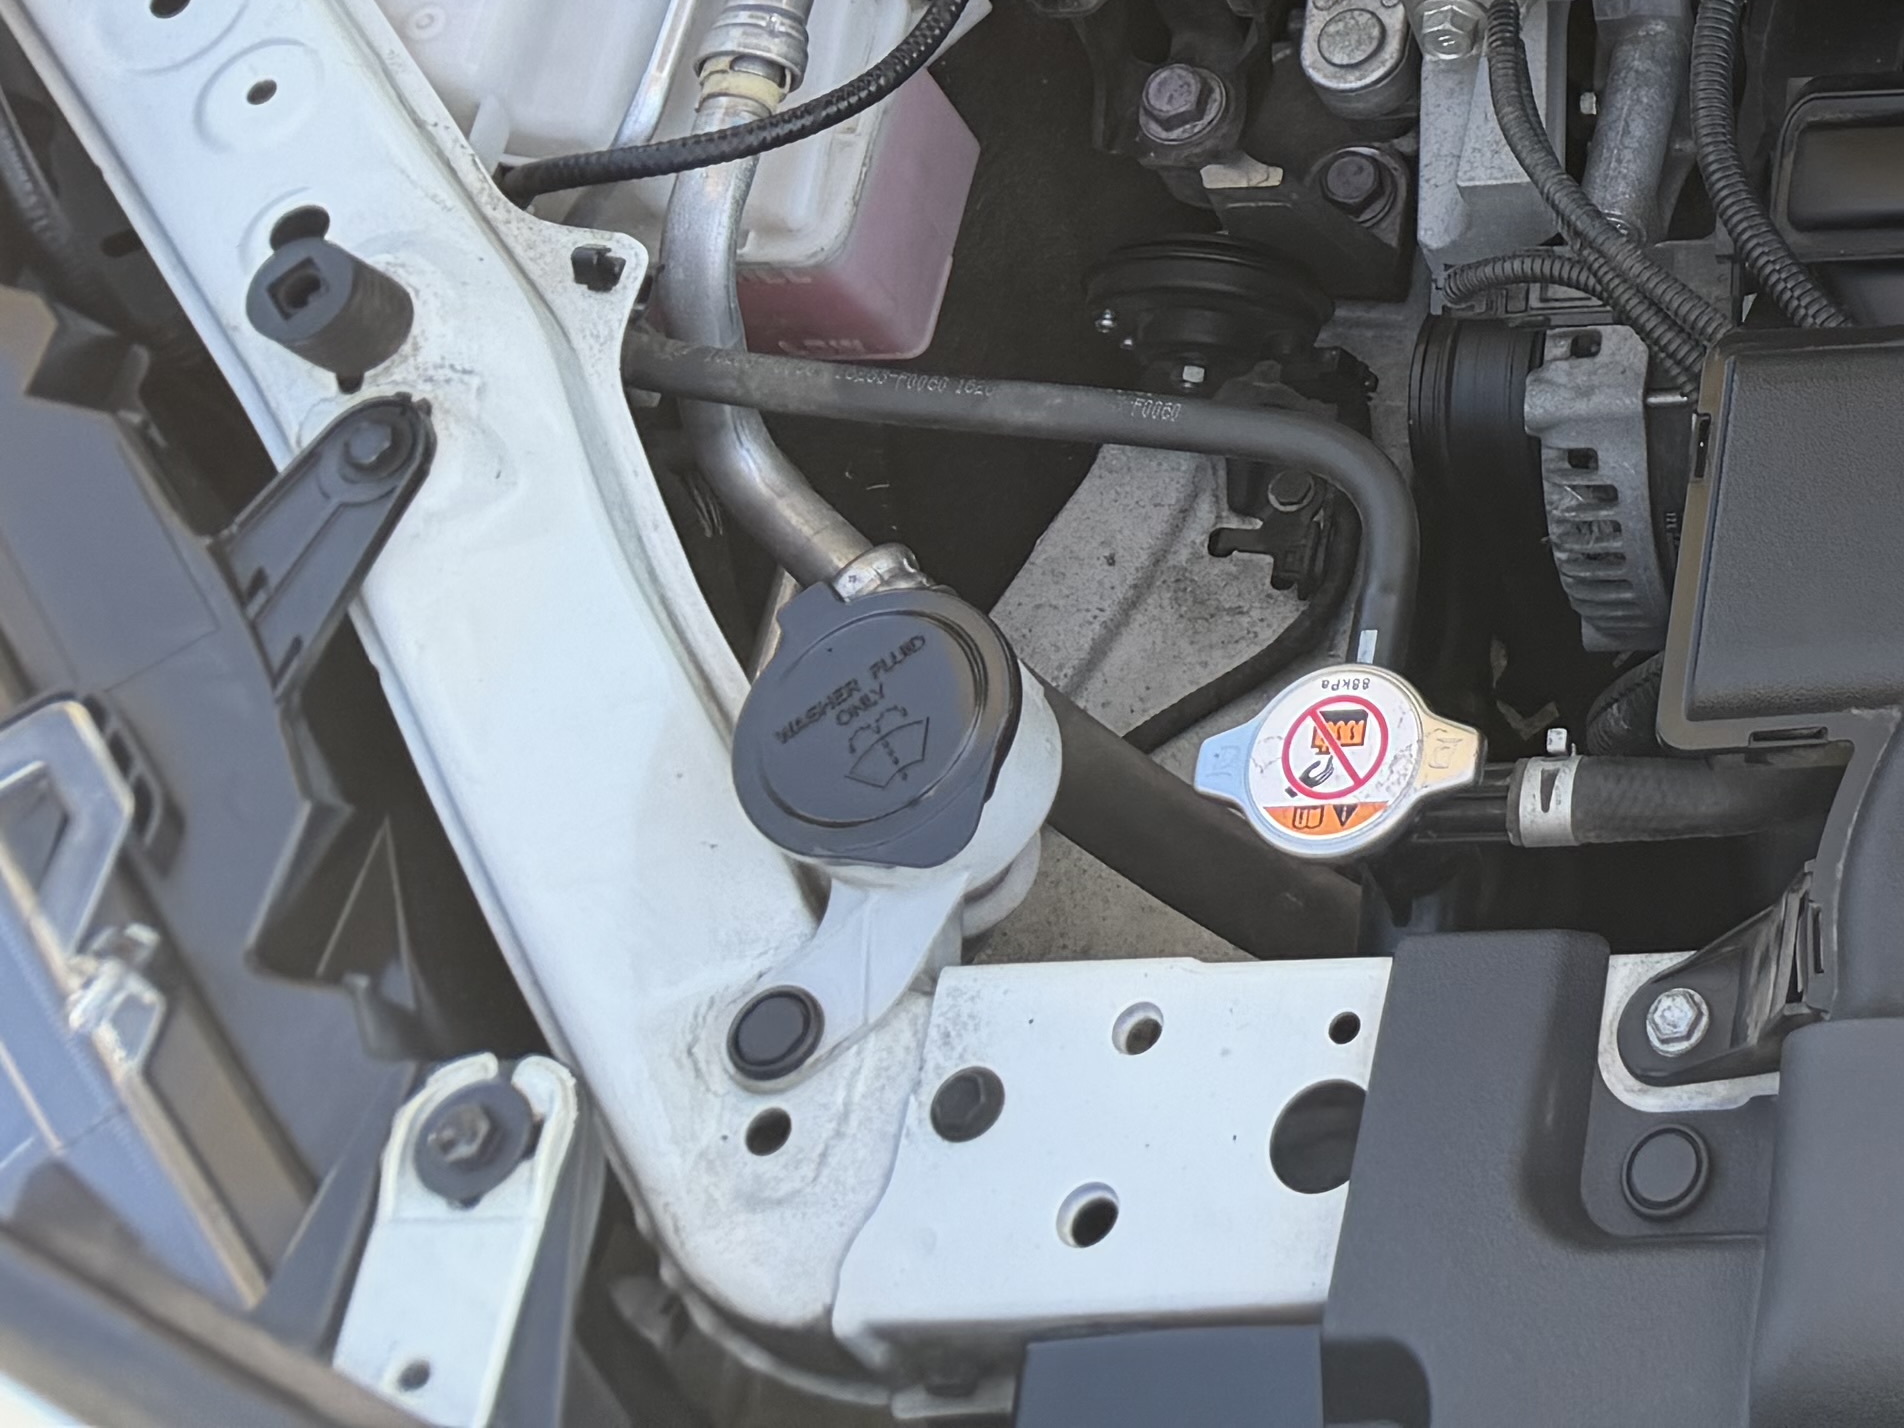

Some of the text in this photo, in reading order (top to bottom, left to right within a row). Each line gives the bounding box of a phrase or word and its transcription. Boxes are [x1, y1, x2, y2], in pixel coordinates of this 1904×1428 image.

[835, 683, 885, 726] ONLY
[1320, 677, 1371, 691] 88kPa
[775, 679, 861, 744] WASHER
